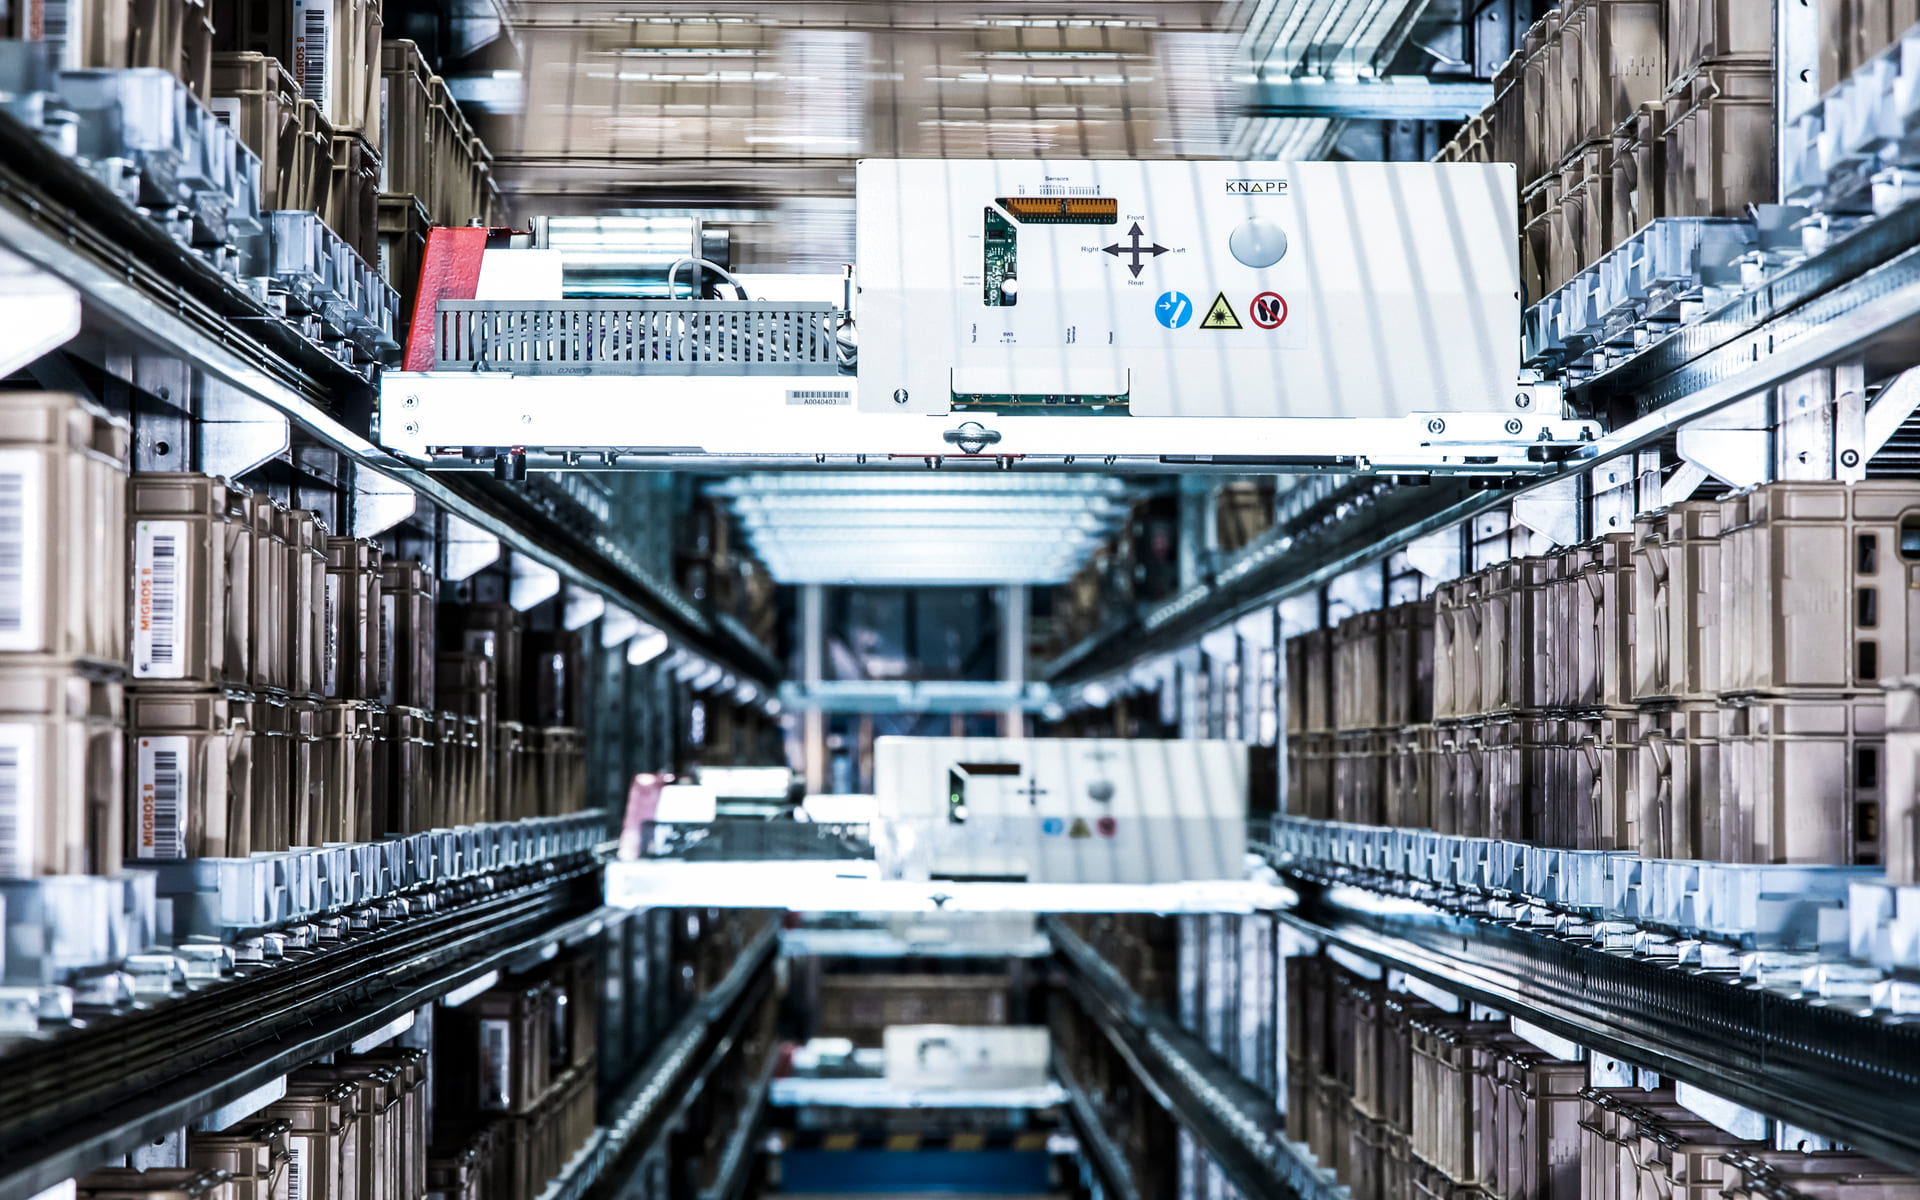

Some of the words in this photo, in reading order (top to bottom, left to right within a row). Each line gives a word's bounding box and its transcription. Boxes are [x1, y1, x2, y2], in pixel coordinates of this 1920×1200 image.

[1226, 182, 1288, 192] KNAPP
[140, 579, 152, 631] MIGROS
[143, 795, 154, 847] MIGROS
